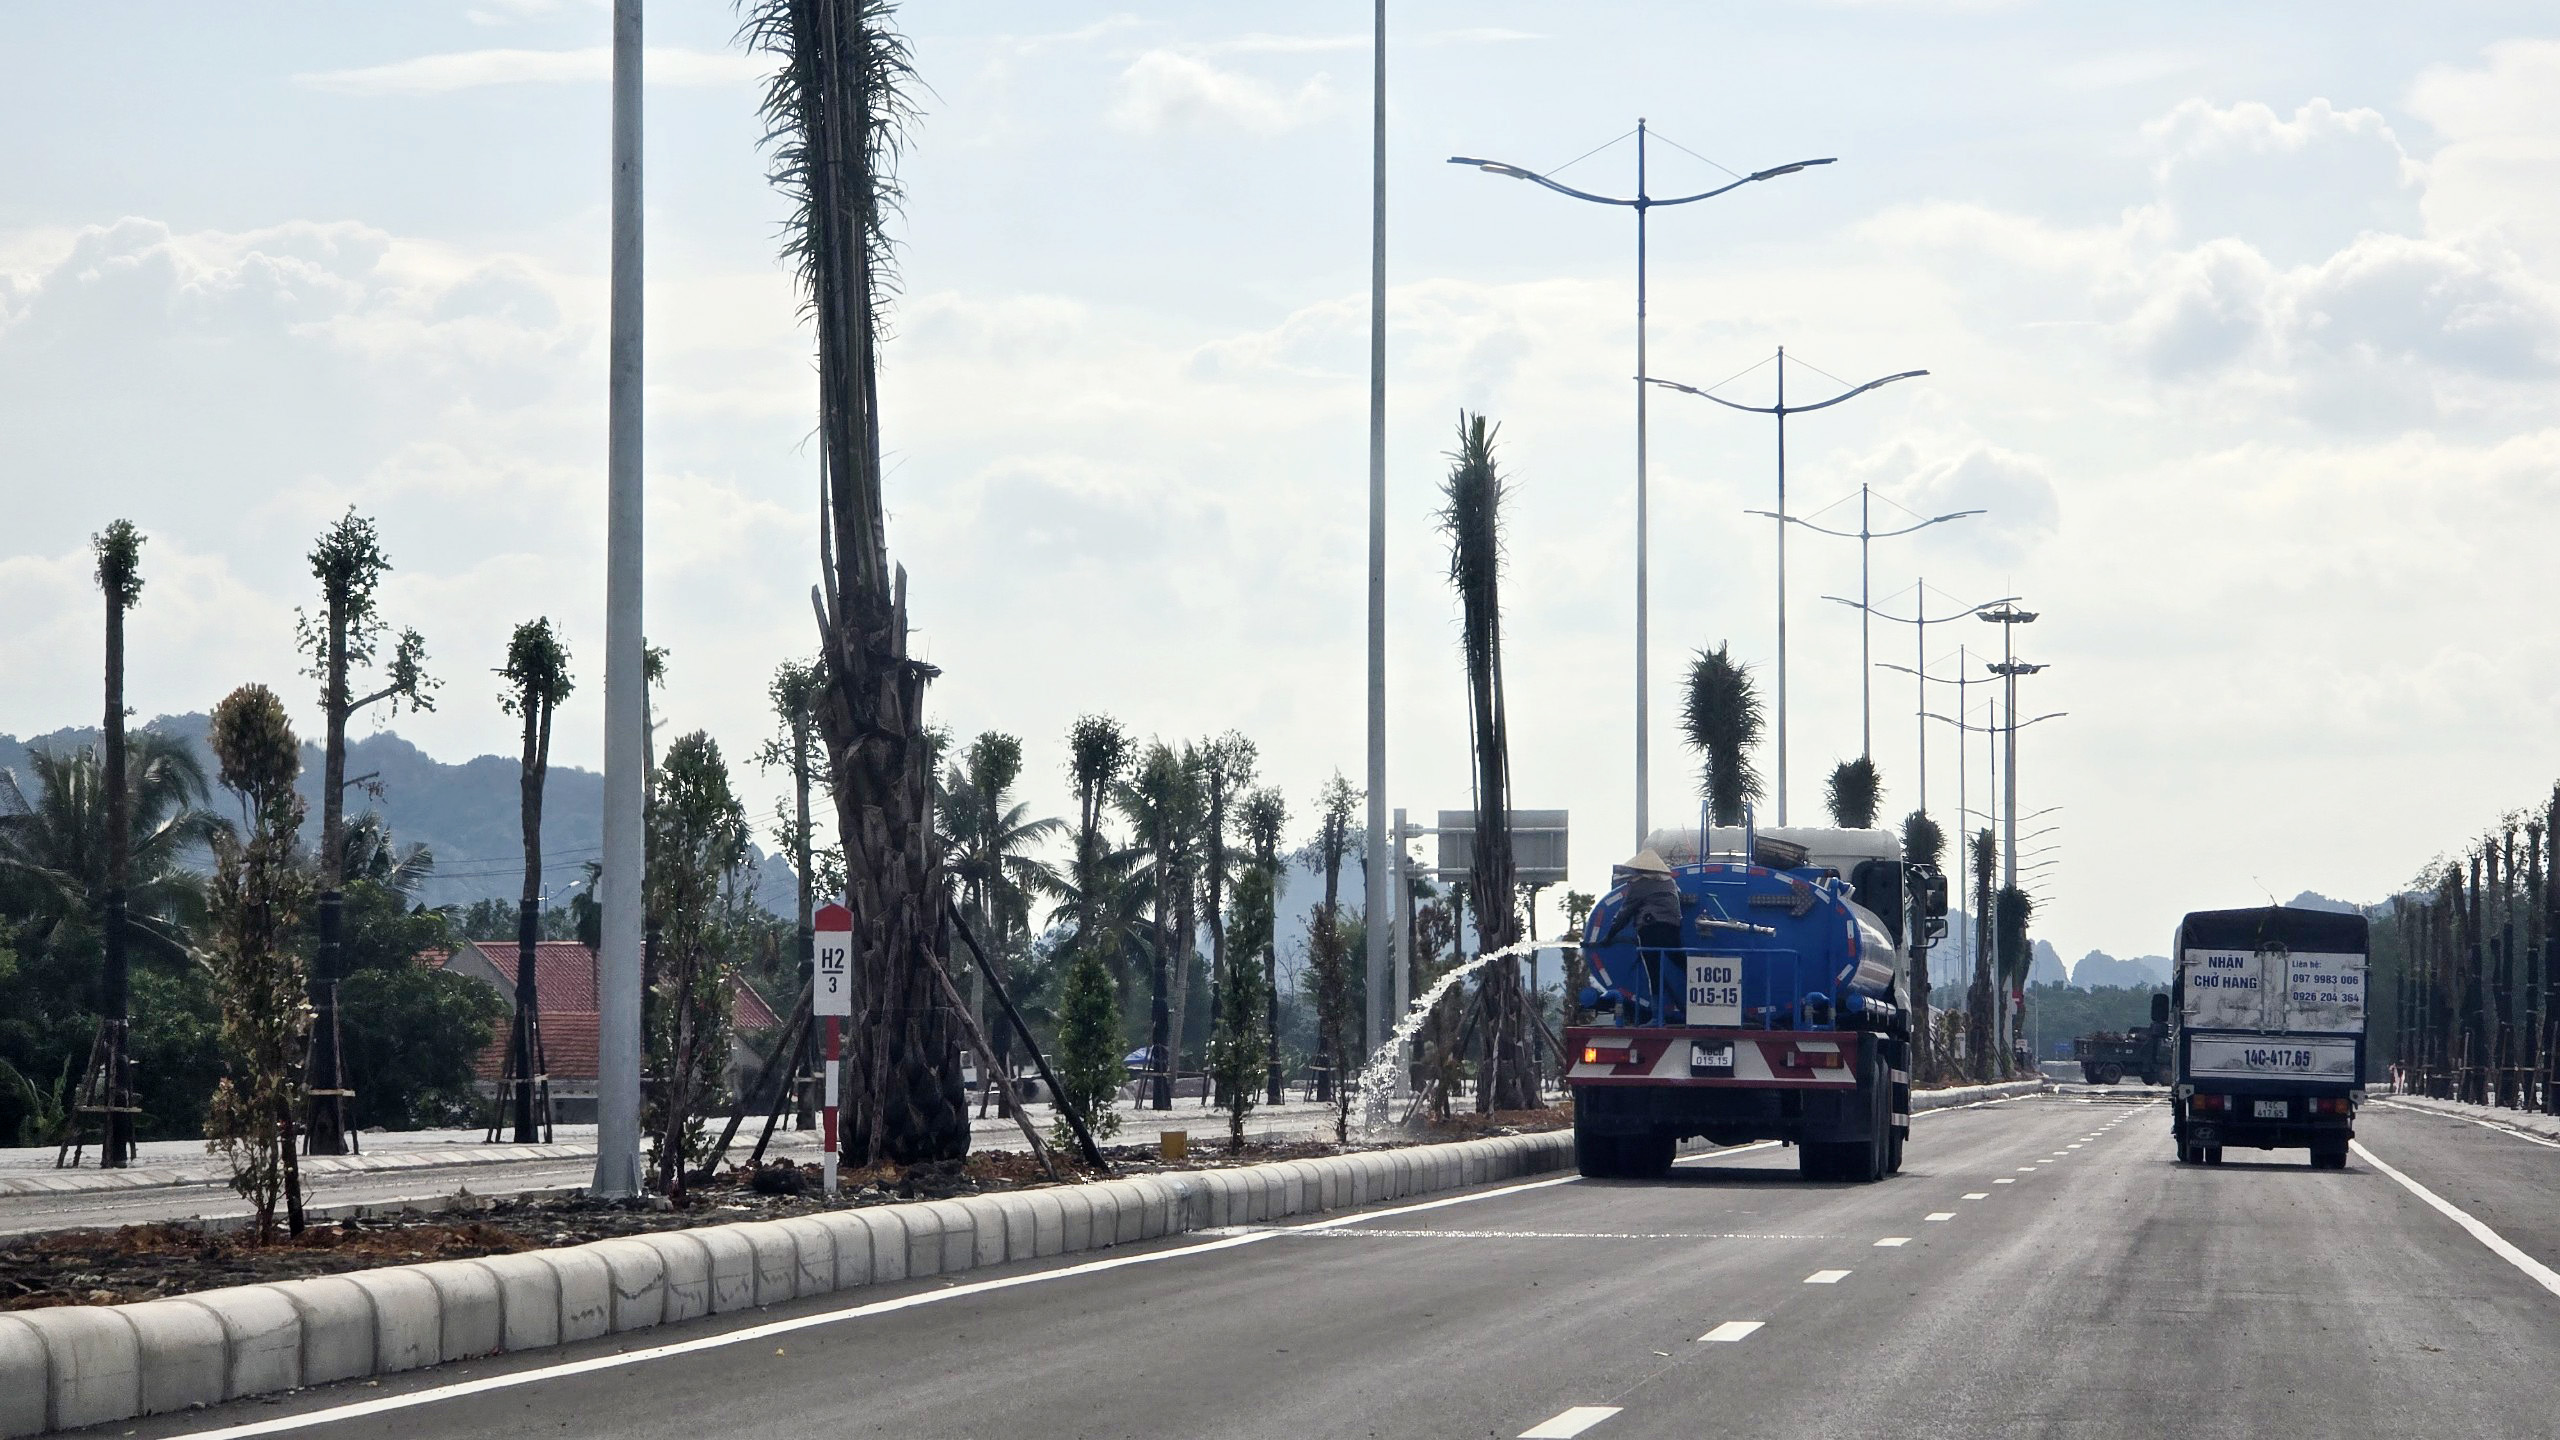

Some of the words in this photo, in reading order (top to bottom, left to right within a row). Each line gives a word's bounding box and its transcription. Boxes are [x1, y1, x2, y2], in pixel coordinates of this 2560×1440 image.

[822, 948, 844, 969] H2
[1696, 967, 1731, 983] 18CD
[2293, 974, 2310, 983] 097
[2314, 975, 2338, 984] 9983
[2341, 976, 2359, 985] 006
[829, 976, 837, 993] 3
[1690, 987, 1738, 1004] 015-15
[2293, 992, 2317, 1001] 0926
[2320, 993, 2338, 1002] 204
[2341, 994, 2359, 1003] 364
[1696, 1056, 1728, 1065] 015.15
[2244, 1049, 2310, 1067] 14C-417.65
[2264, 1101, 2278, 1109] 14C
